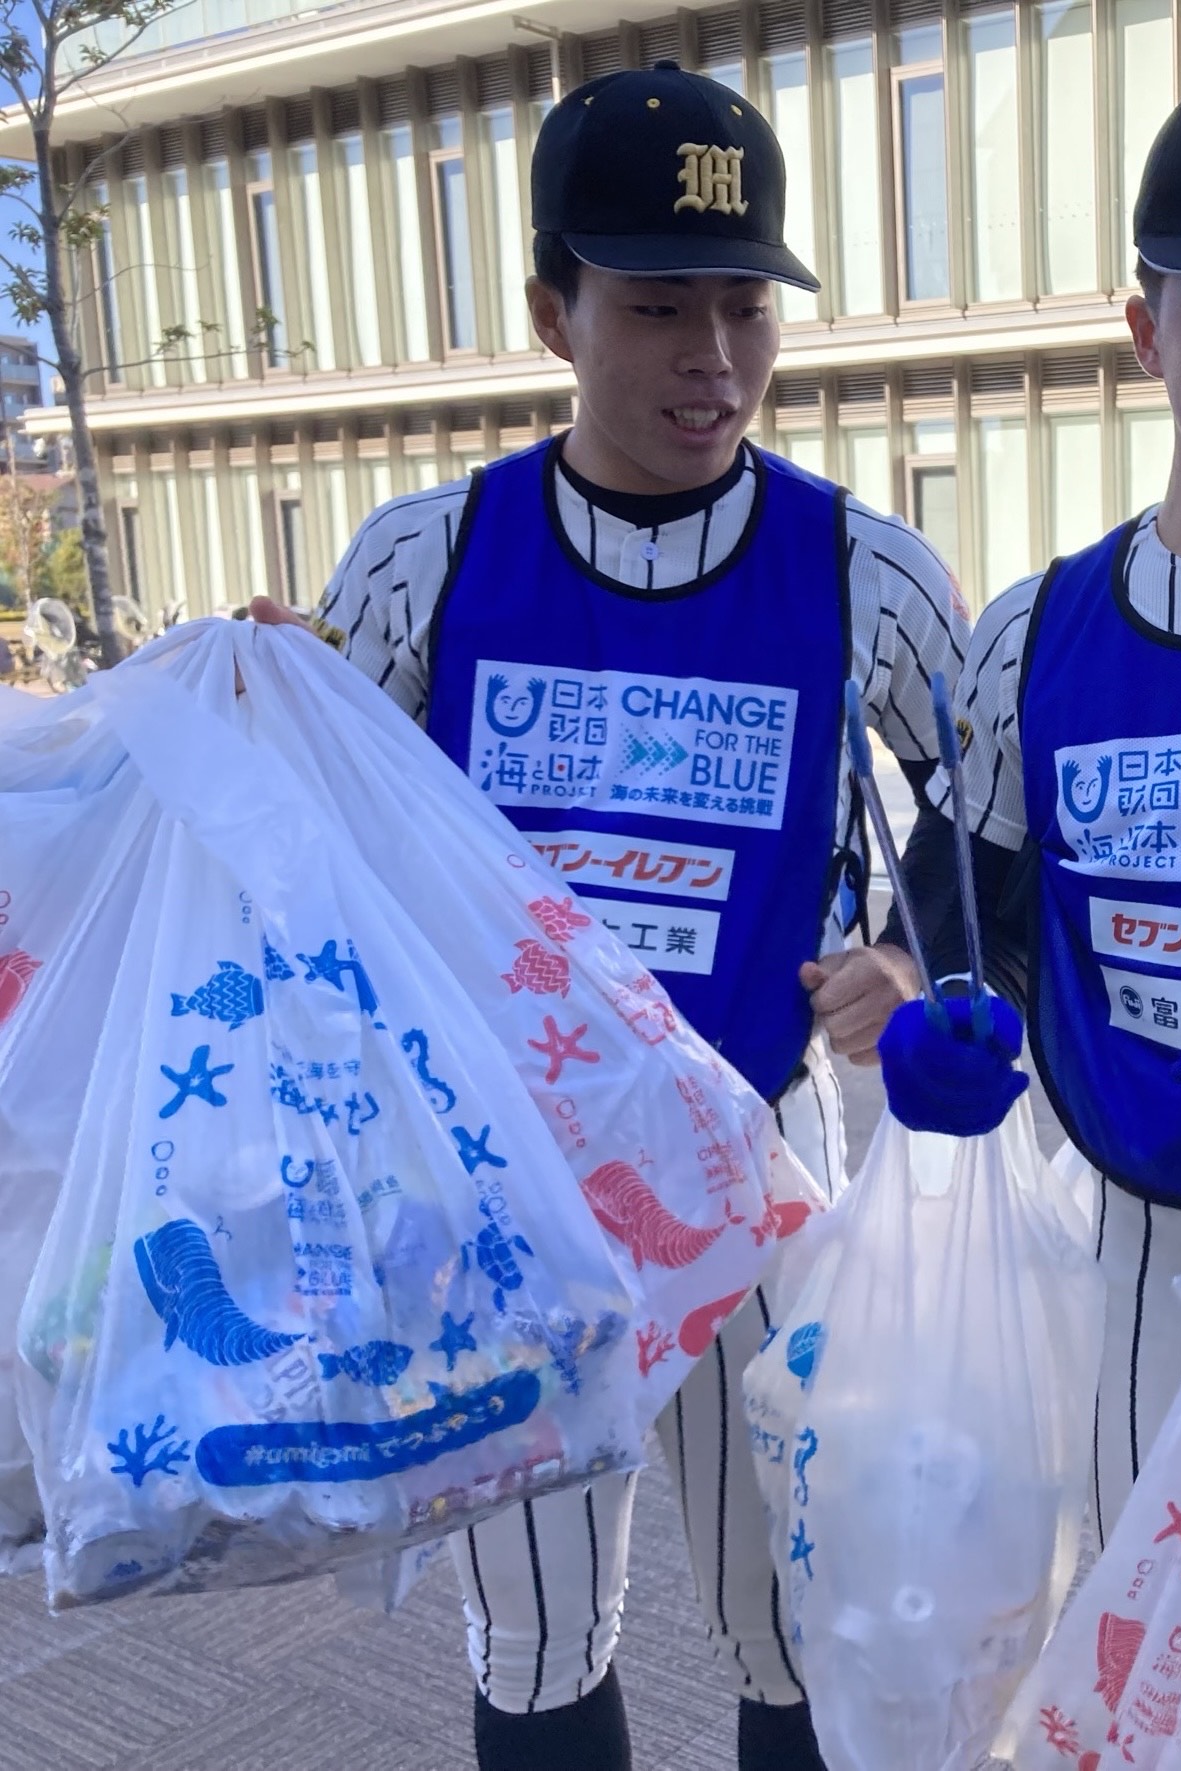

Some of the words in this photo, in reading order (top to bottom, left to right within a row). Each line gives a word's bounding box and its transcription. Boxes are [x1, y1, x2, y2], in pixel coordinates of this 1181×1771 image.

[552, 679, 608, 710] 日本
[621, 686, 788, 732] CHANGE
[695, 729, 738, 751] FOR
[745, 734, 782, 757] THE
[691, 755, 779, 794] BLUE
[610, 784, 773, 817] 海の未来を変える挑戦
[1101, 854, 1177, 869] ROJECT
